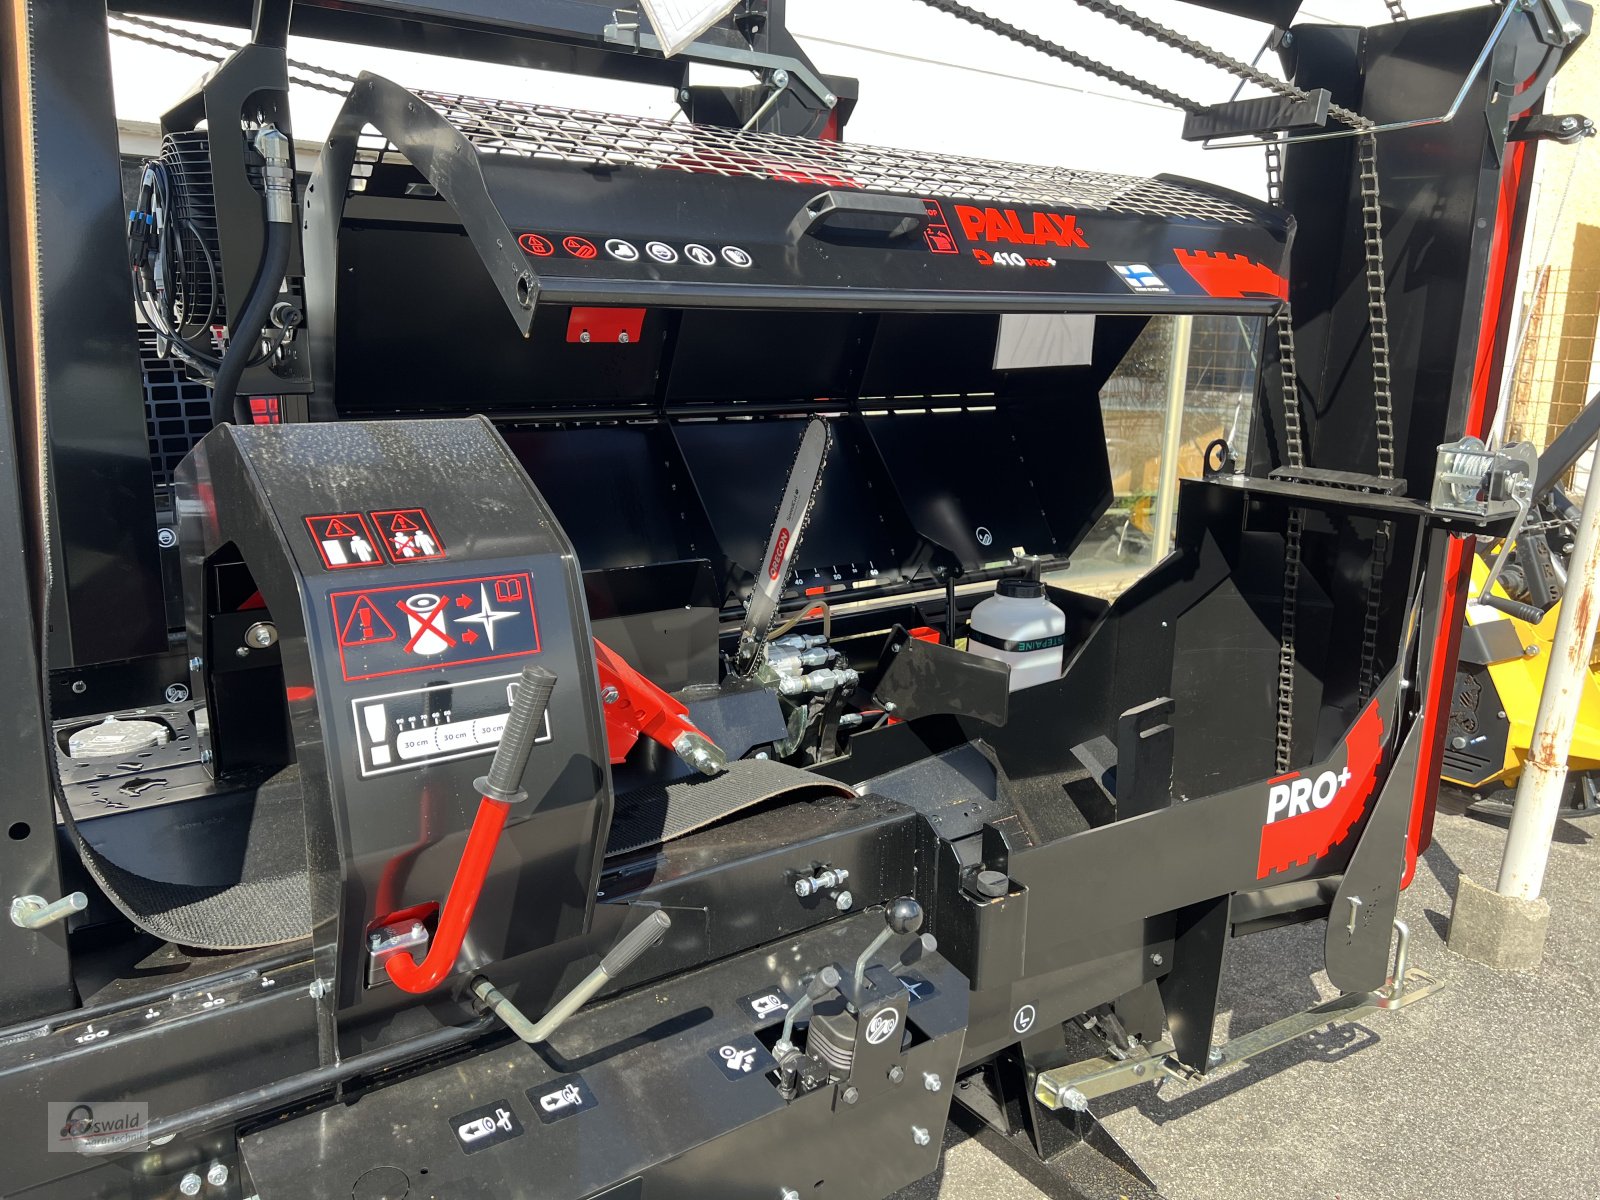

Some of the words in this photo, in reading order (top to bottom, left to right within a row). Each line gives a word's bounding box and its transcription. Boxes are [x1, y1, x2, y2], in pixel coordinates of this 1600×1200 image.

[770, 532, 788, 576] OREGON
[1266, 766, 1352, 825] PRO+
[74, 1029, 110, 1044] 100
